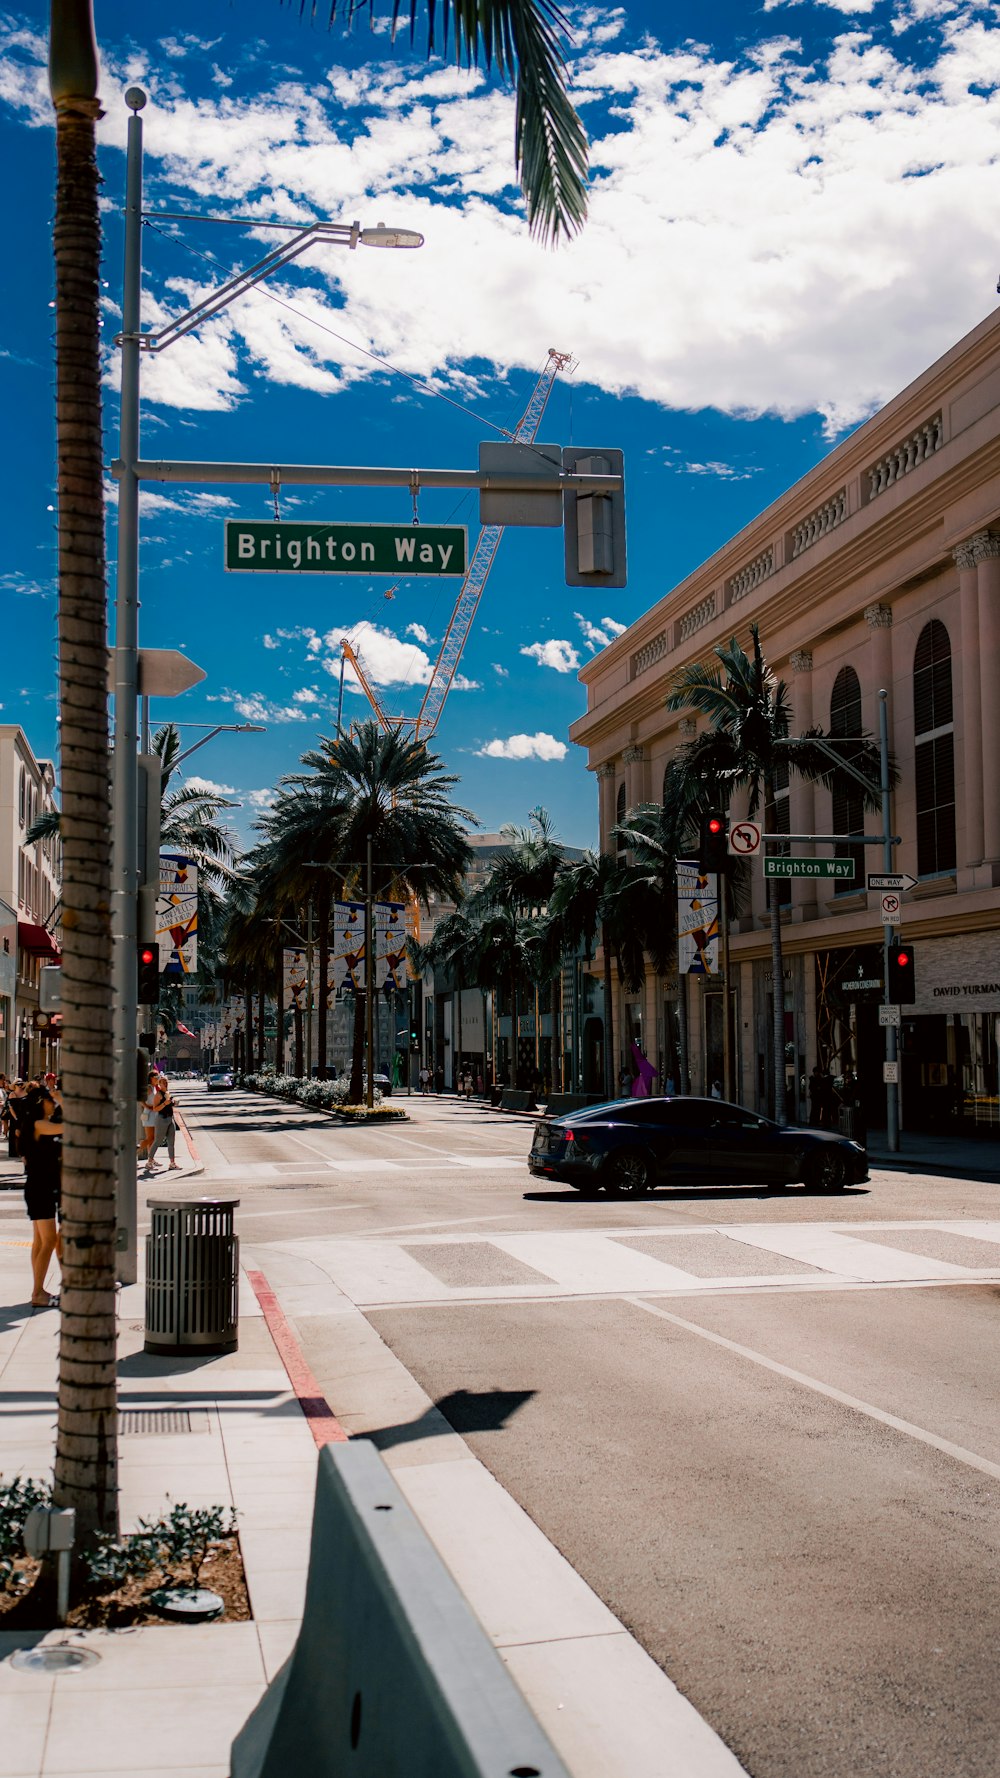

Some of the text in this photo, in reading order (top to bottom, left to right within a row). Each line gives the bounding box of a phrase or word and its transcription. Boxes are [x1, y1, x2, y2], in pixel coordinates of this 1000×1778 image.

[238, 533, 453, 570] Brighton Way
[767, 862, 850, 876] Brighton Way
[682, 907, 715, 925] TIMEPIECES
[933, 984, 1000, 997] DAVID YURMAN
